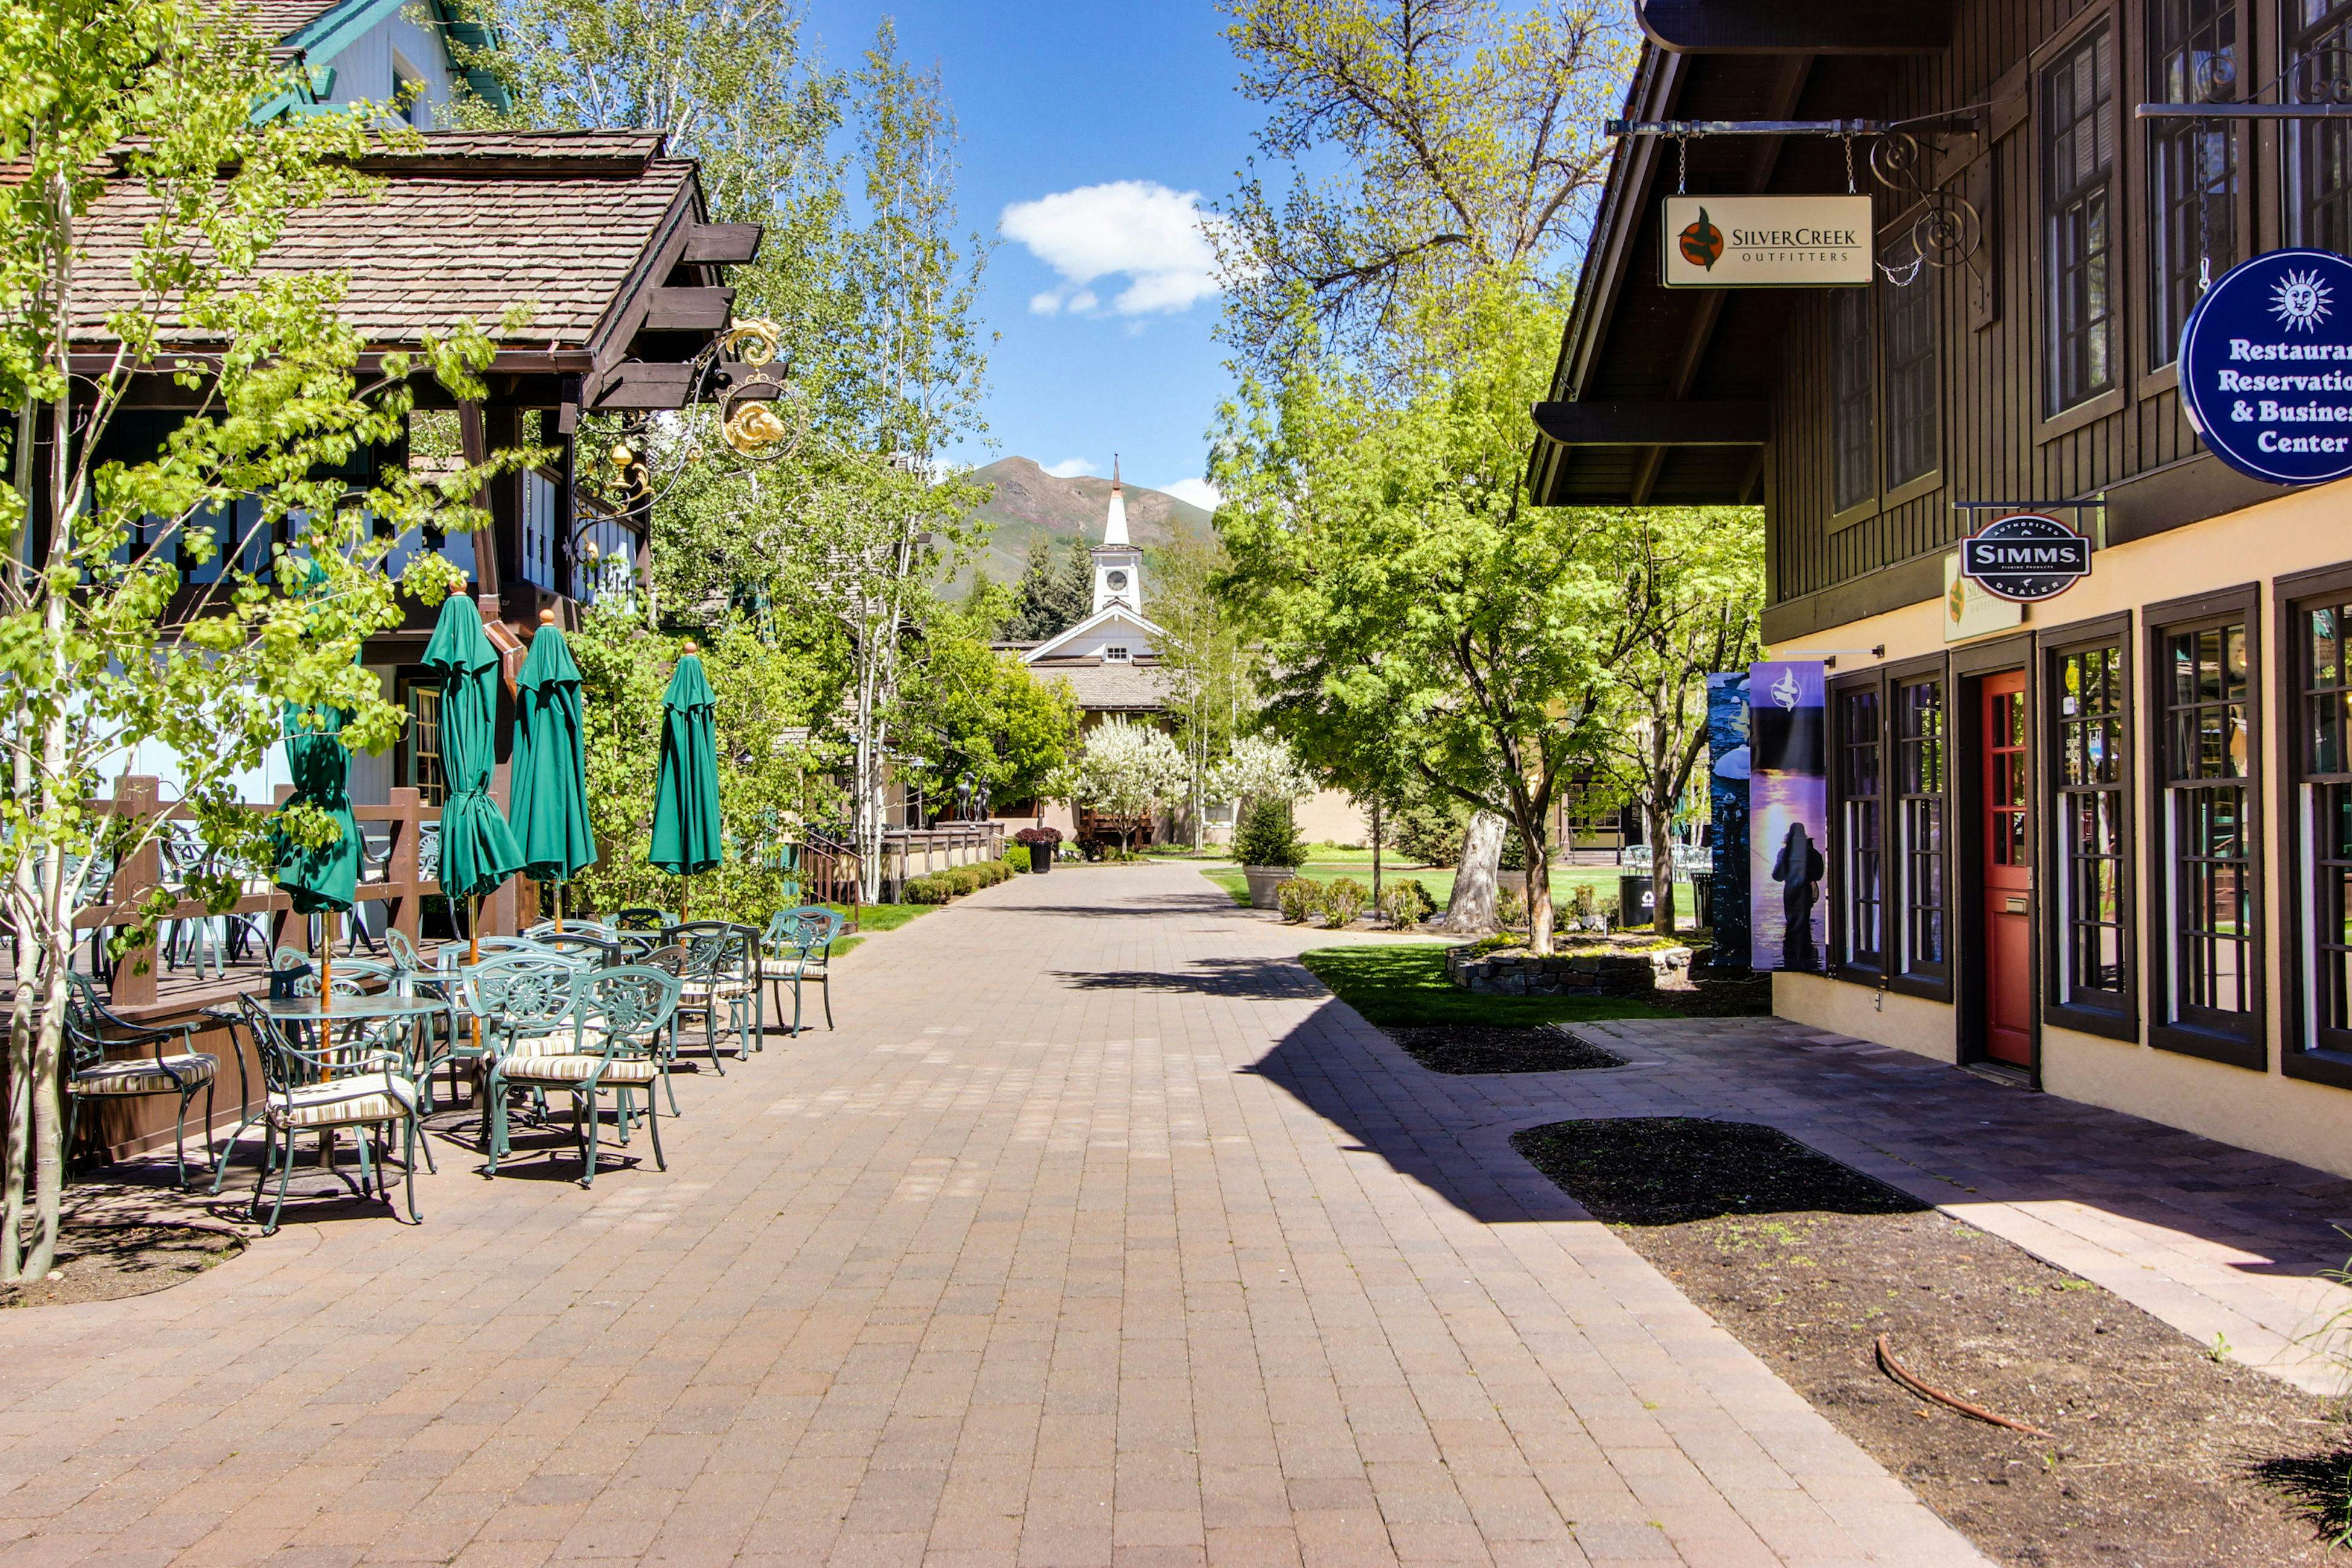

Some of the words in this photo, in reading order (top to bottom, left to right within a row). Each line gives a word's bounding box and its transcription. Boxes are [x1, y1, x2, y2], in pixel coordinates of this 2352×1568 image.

[1732, 228, 1856, 246] SILVERCREEK
[1742, 253, 1848, 262] OUTFITTERS
[2231, 400, 2254, 422] &
[2257, 431, 2349, 453] Center
[1994, 522, 2059, 536] AUTHORIZED
[1996, 581, 2059, 595] DEALER
